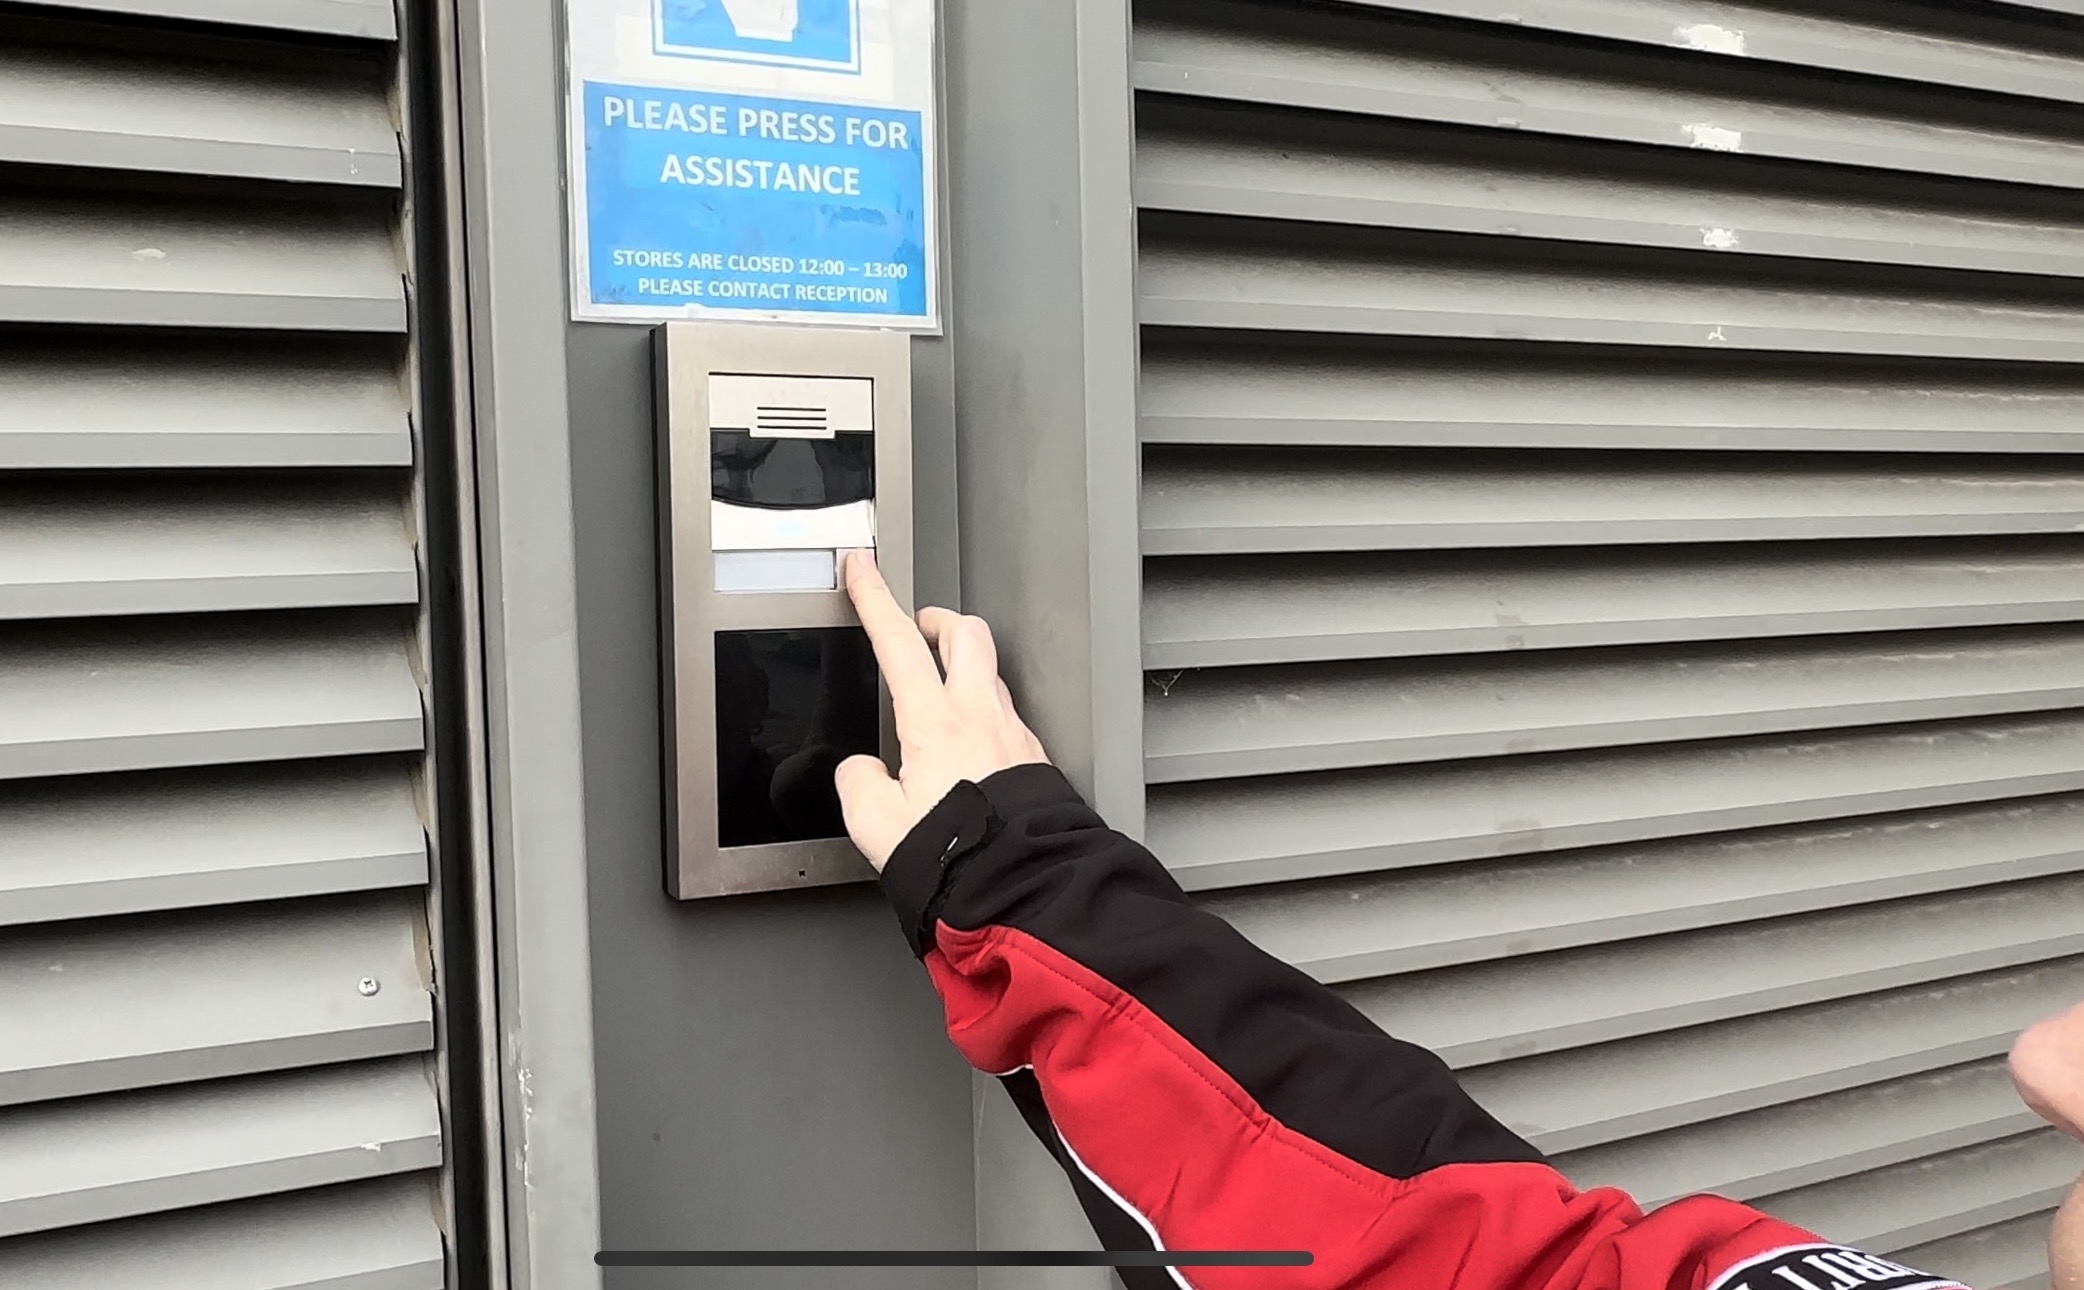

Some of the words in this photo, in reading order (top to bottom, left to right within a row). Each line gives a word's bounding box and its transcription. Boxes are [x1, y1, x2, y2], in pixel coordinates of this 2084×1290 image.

[603, 96, 728, 136] PLEASE
[738, 107, 836, 144] PRESS
[846, 117, 908, 150] FOR
[660, 153, 860, 196] ASSISTANCE
[613, 248, 683, 270] STORES
[688, 252, 724, 272] ARE
[728, 254, 794, 274] CLOSED
[799, 257, 845, 277] 12:00
[863, 261, 908, 281] 13:00
[638, 278, 703, 298] PLEASE
[708, 280, 790, 301] CONTACT
[795, 285, 888, 305] RECEPTION
